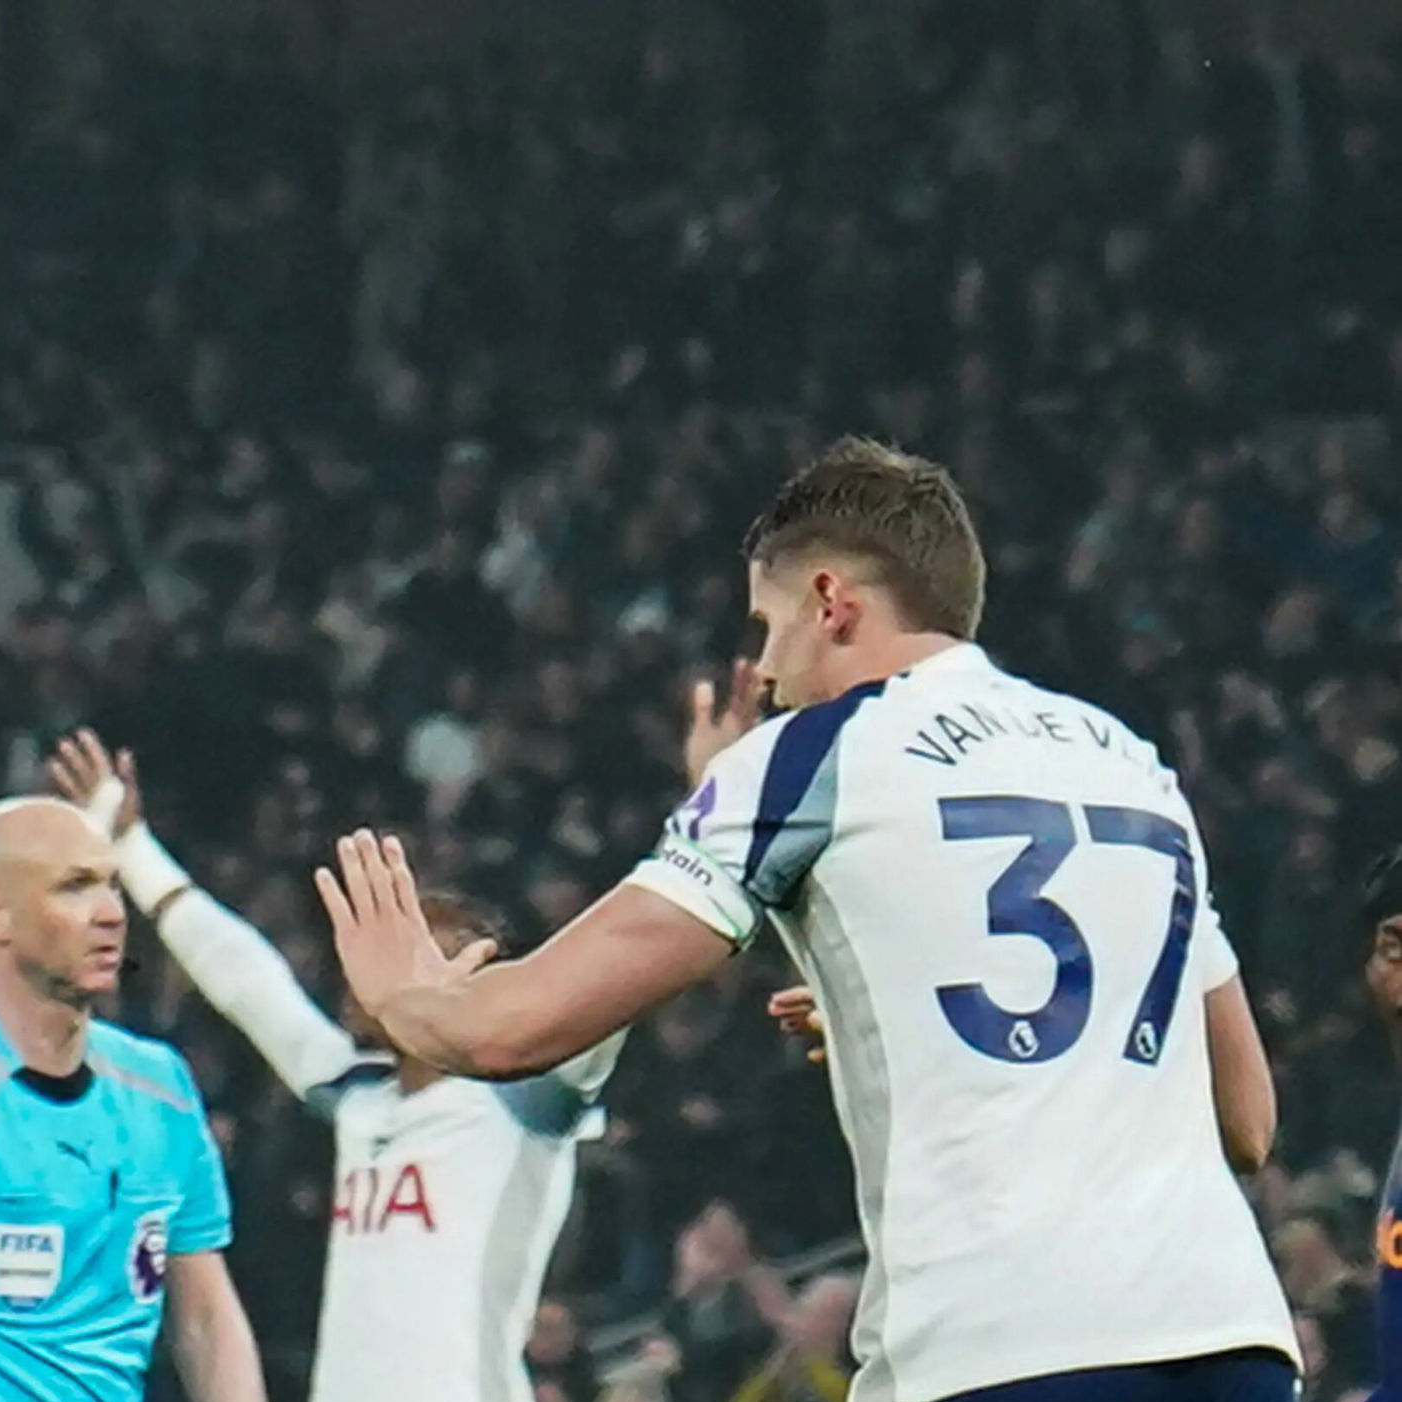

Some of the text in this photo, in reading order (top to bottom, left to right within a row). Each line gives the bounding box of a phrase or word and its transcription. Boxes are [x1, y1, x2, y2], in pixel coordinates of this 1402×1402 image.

[904, 702, 1008, 766] VAN
[935, 794, 1197, 1066] 37
[0, 1232, 53, 1253] FIFA
